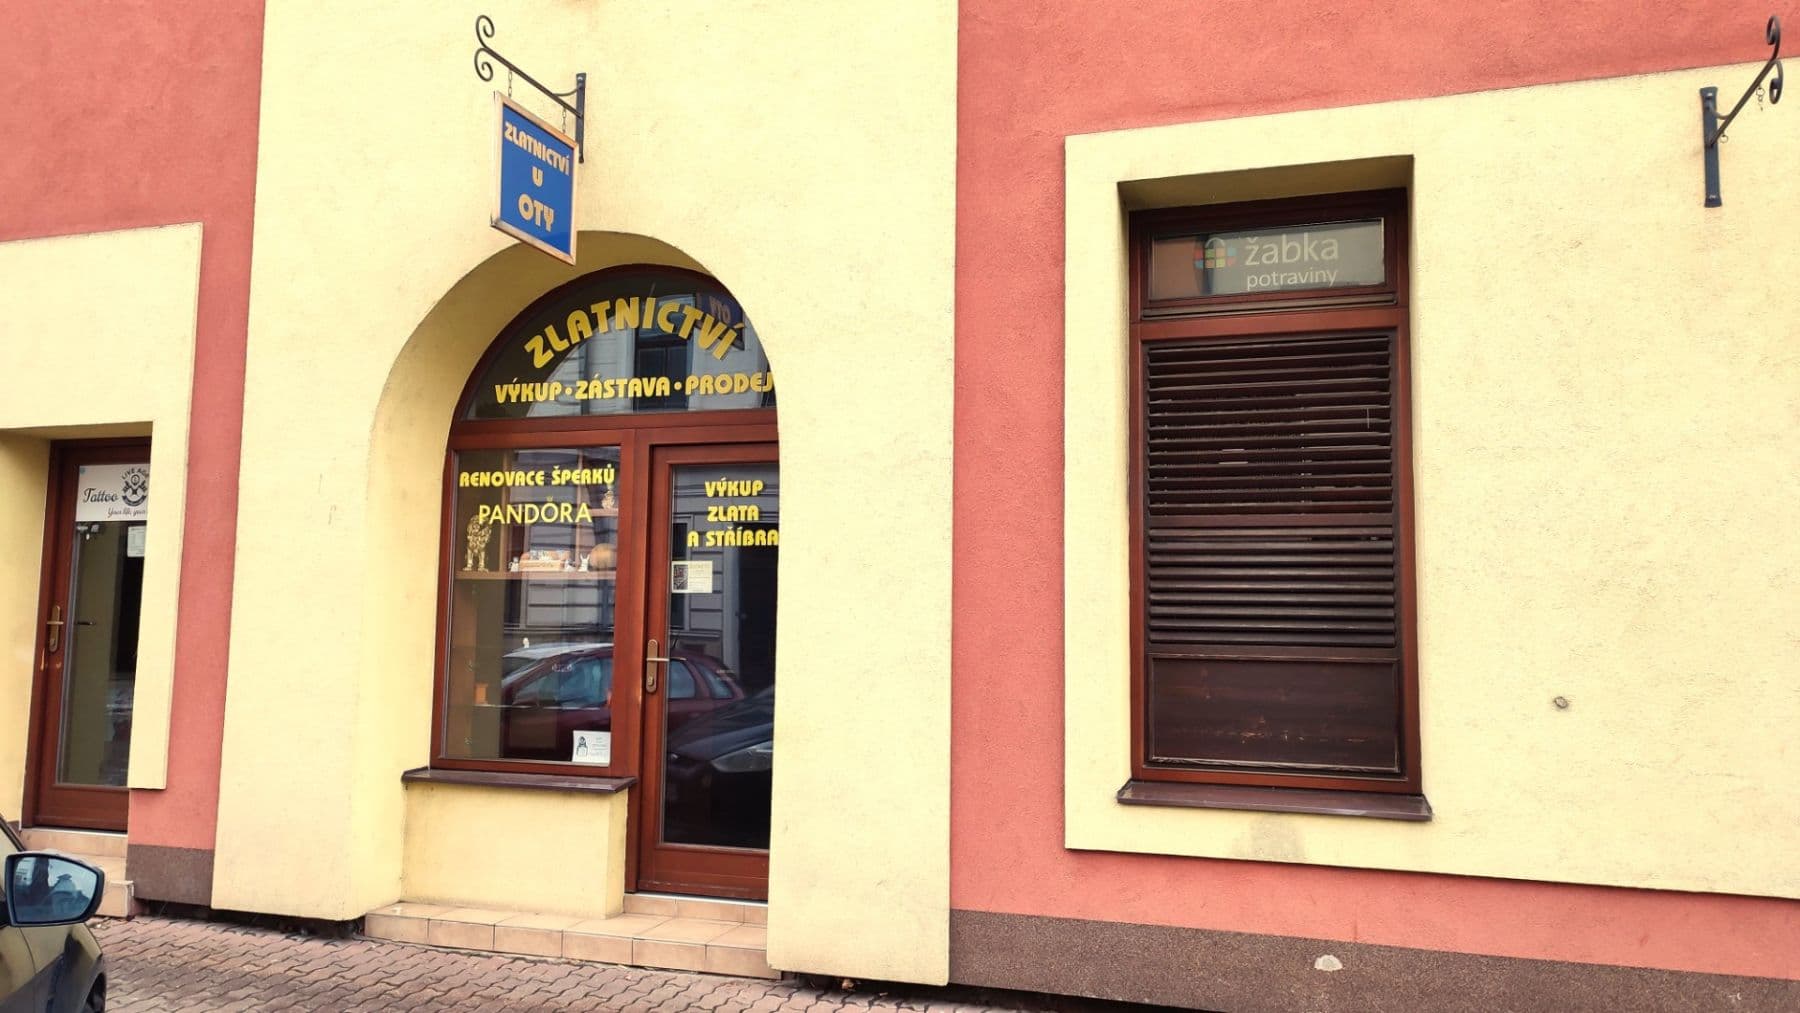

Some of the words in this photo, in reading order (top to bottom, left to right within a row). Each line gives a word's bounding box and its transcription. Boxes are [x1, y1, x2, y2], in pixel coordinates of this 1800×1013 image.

[504, 121, 570, 176] ZLATNICTVÍ
[532, 166, 544, 187] U
[518, 193, 555, 232] OTY
[1245, 233, 1339, 266] žabka
[1246, 267, 1339, 291] potraviny
[524, 297, 745, 369] ZLATNICTVÍ
[495, 377, 562, 404] VÝKUP
[575, 373, 670, 400] ZÁSTAVA
[686, 371, 773, 397] PRODEJ
[459, 470, 545, 487] RENOVACE
[552, 464, 615, 486] ŠPERKŮ
[705, 477, 764, 498] VÝKUP
[83, 487, 119, 503] Tattoo
[478, 500, 592, 525] PANDORA
[707, 505, 759, 522] ZLATA
[687, 532, 699, 548] A
[705, 526, 779, 547] STŘÍBRA
